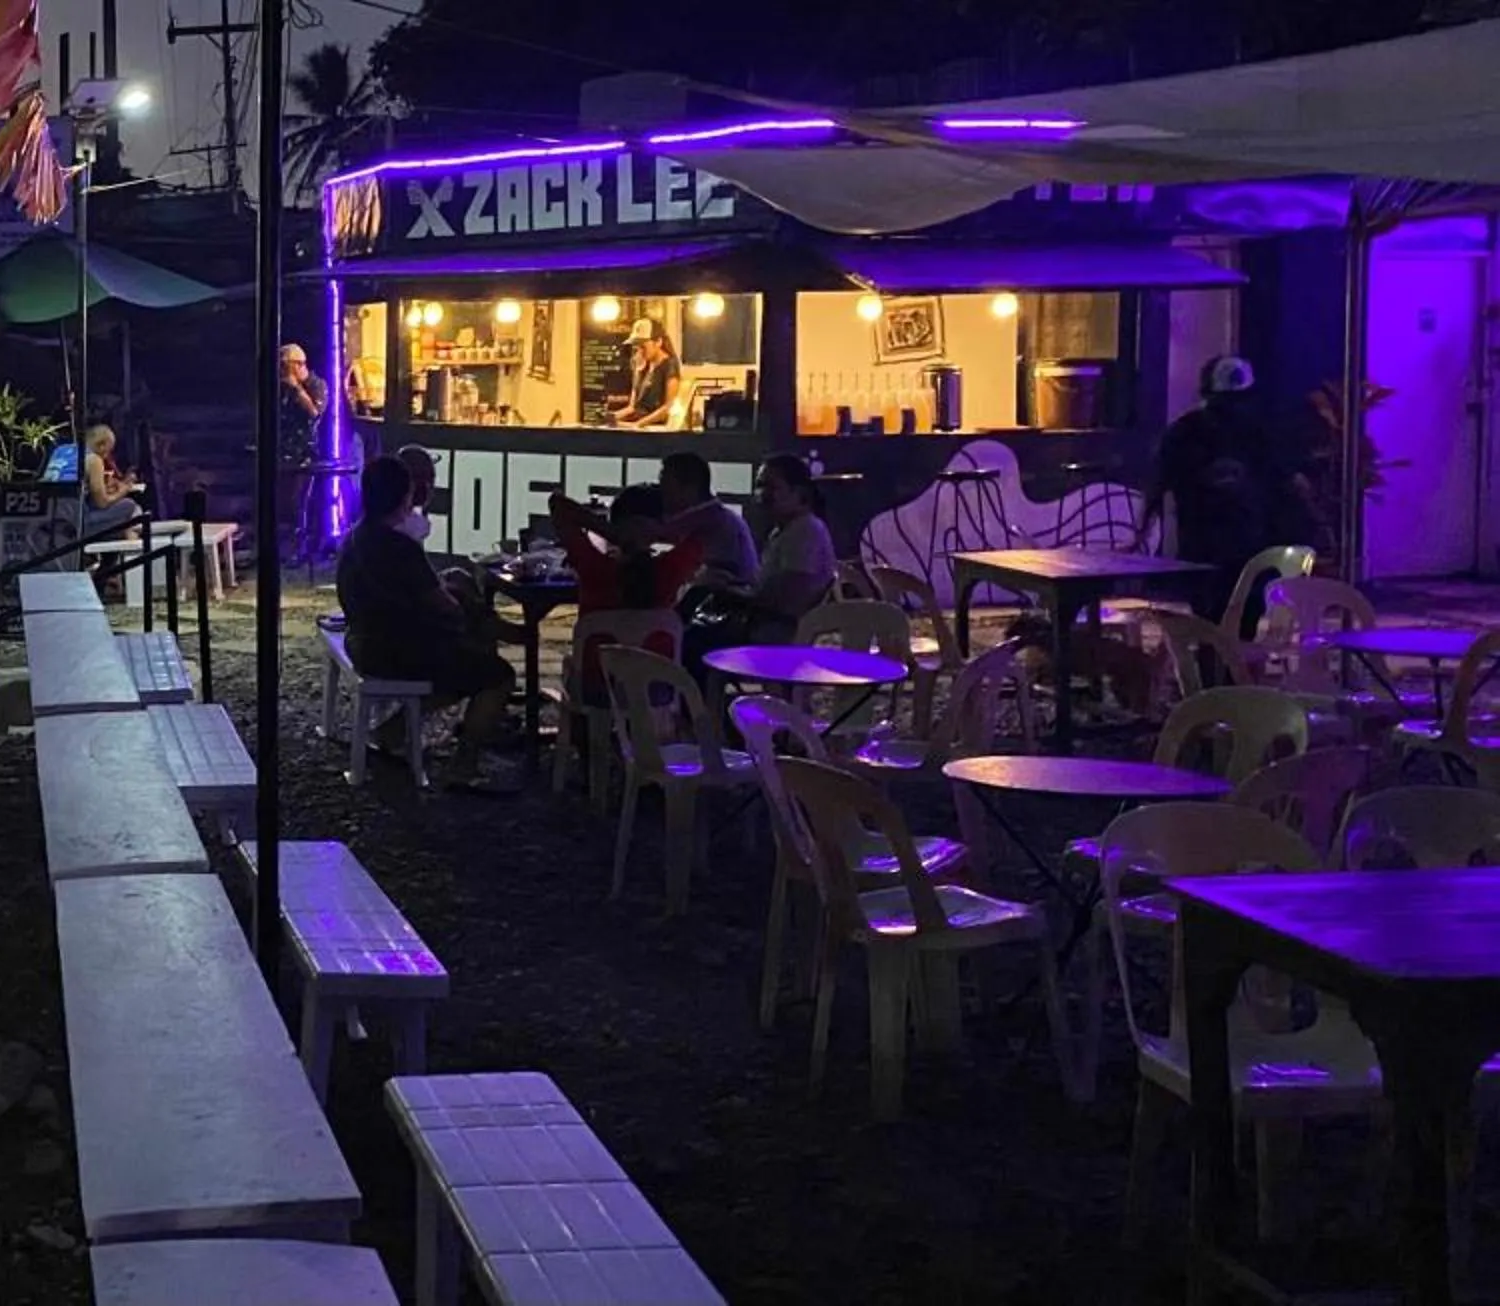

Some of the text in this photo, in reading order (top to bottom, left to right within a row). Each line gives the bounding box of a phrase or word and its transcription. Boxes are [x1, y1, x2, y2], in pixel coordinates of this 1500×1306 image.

[463, 156, 604, 236] ZACK
[4, 490, 42, 514] P25
[422, 447, 755, 558] OFF
